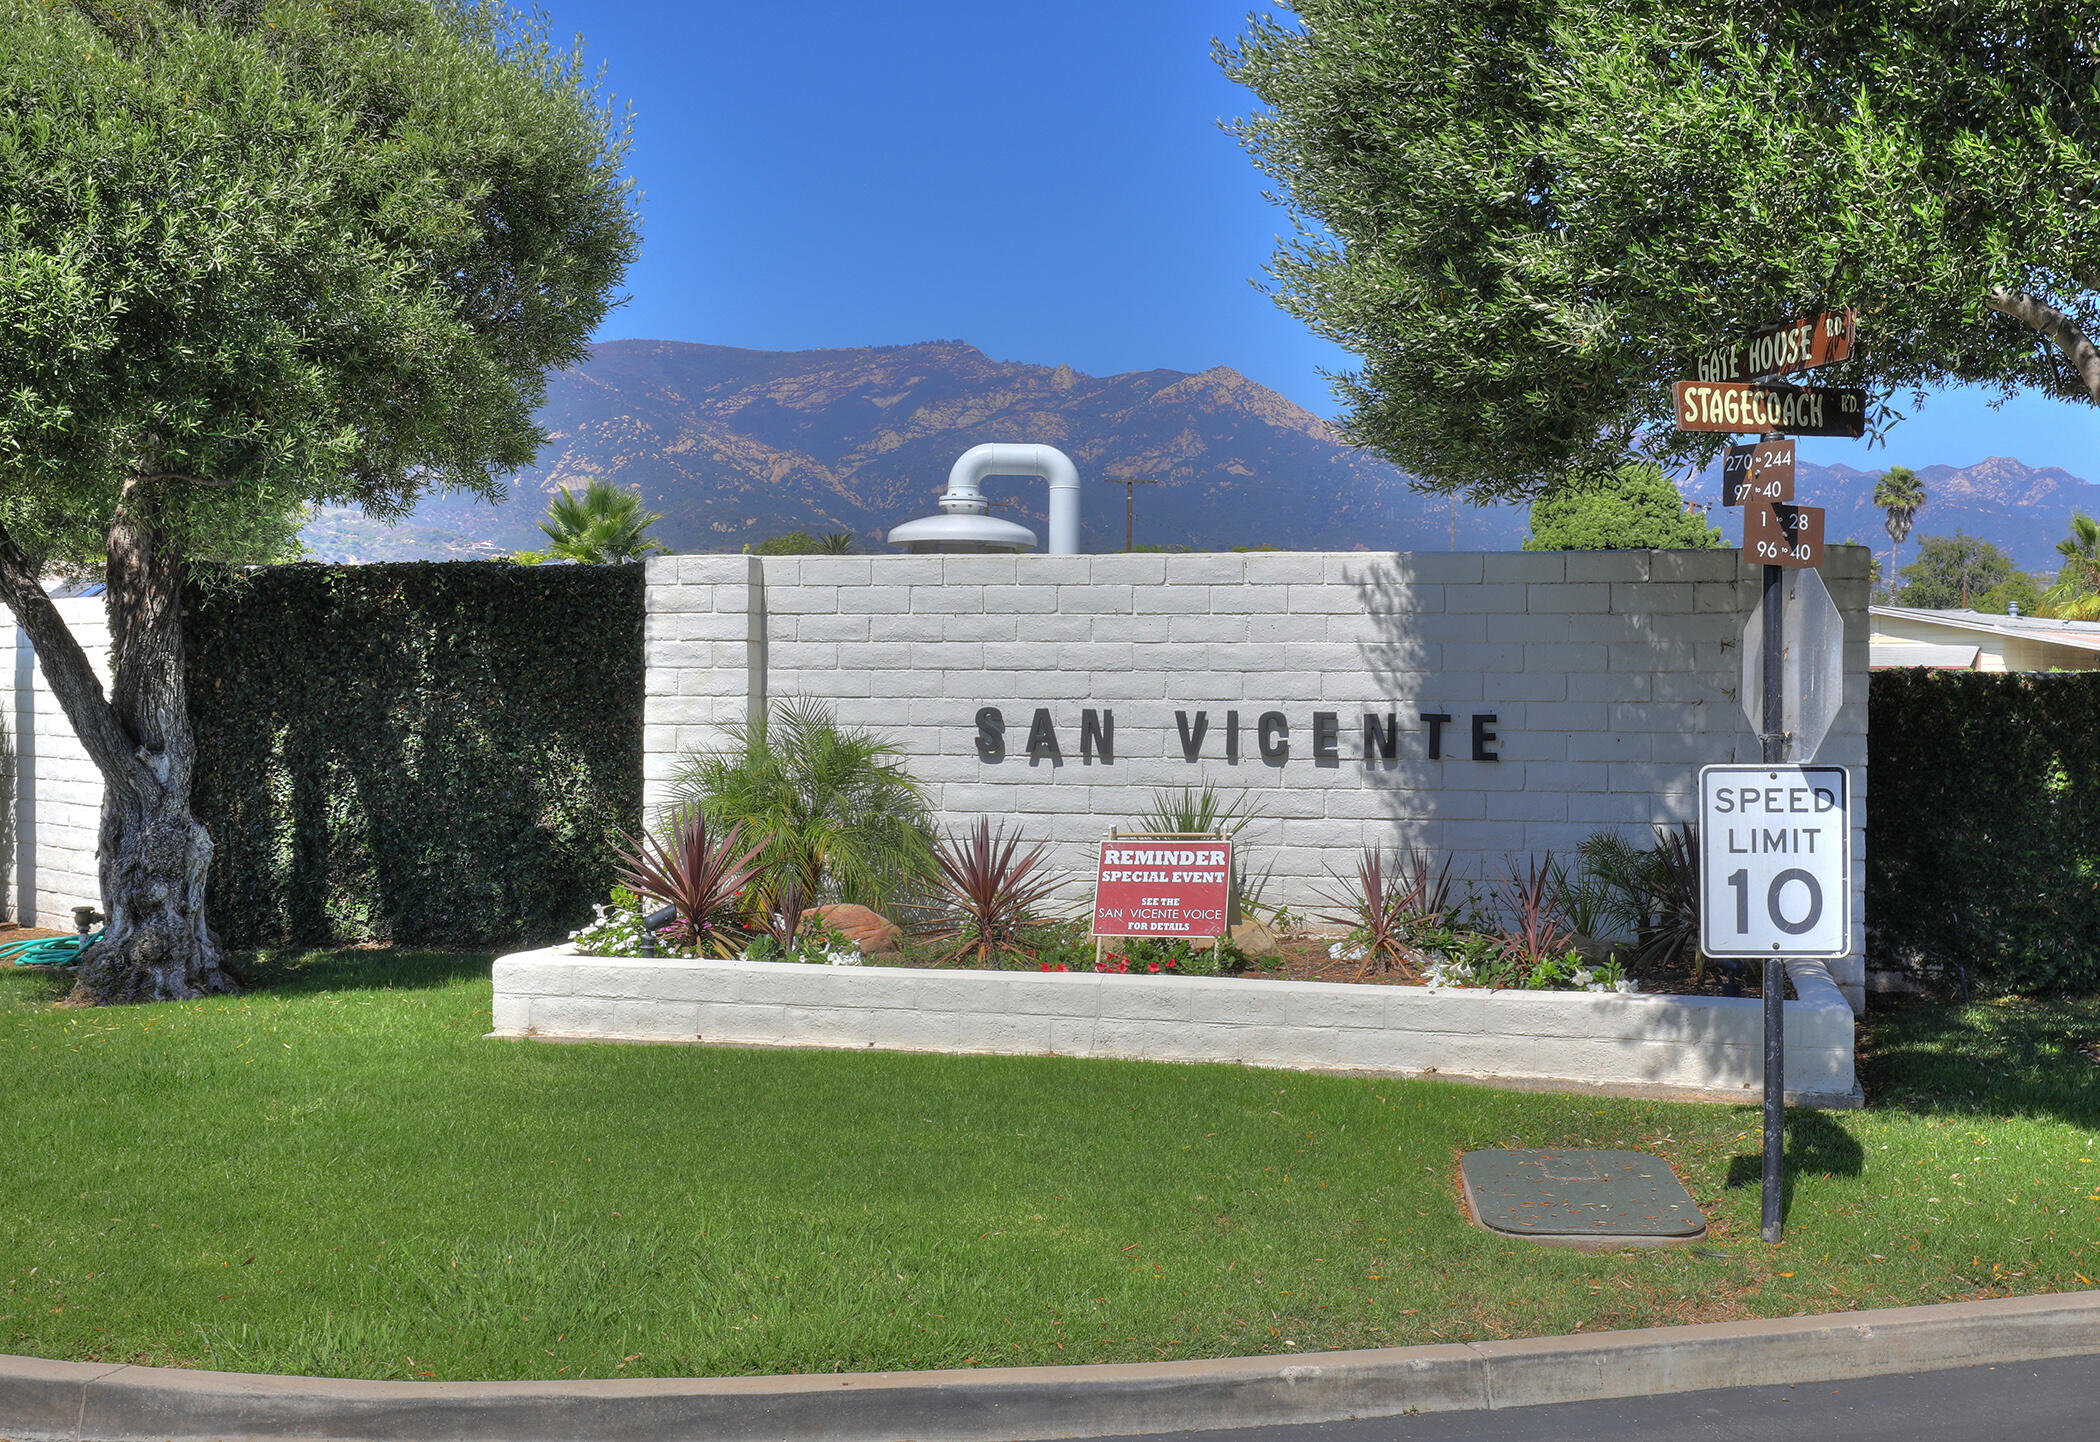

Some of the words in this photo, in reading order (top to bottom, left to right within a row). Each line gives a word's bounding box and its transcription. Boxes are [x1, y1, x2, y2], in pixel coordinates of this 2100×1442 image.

[1698, 345, 1739, 382] GATE
[1750, 324, 1813, 373] HOUSE
[1826, 316, 1845, 337] RD.
[1684, 387, 1824, 428] STAGECOACH
[1841, 394, 1861, 413] RD.
[1726, 454, 1753, 472] 270
[1763, 450, 1791, 468] 244
[1734, 484, 1753, 501] 97
[1762, 481, 1782, 498] 40
[1760, 512, 1766, 526] 1
[1789, 513, 1809, 530] 28
[1757, 541, 1778, 559] 96
[1790, 543, 1811, 561] 40
[974, 706, 1113, 761] SAN
[1175, 709, 1498, 763] VICENTE
[1714, 787, 1836, 814] SPEED
[1728, 828, 1821, 854] LIMIT
[1104, 850, 1226, 866] REMINDER
[1101, 871, 1169, 883] SPECIAL
[1172, 871, 1225, 884] EVENT
[1141, 897, 1159, 906] SEE
[1160, 897, 1180, 906] THE
[1727, 867, 1823, 936] 10
[1098, 908, 1123, 918] SAN
[1130, 908, 1179, 919] VICENTE
[1182, 909, 1222, 920] VOICE
[1127, 922, 1148, 930] FOR
[1149, 922, 1190, 931] DETAILS
